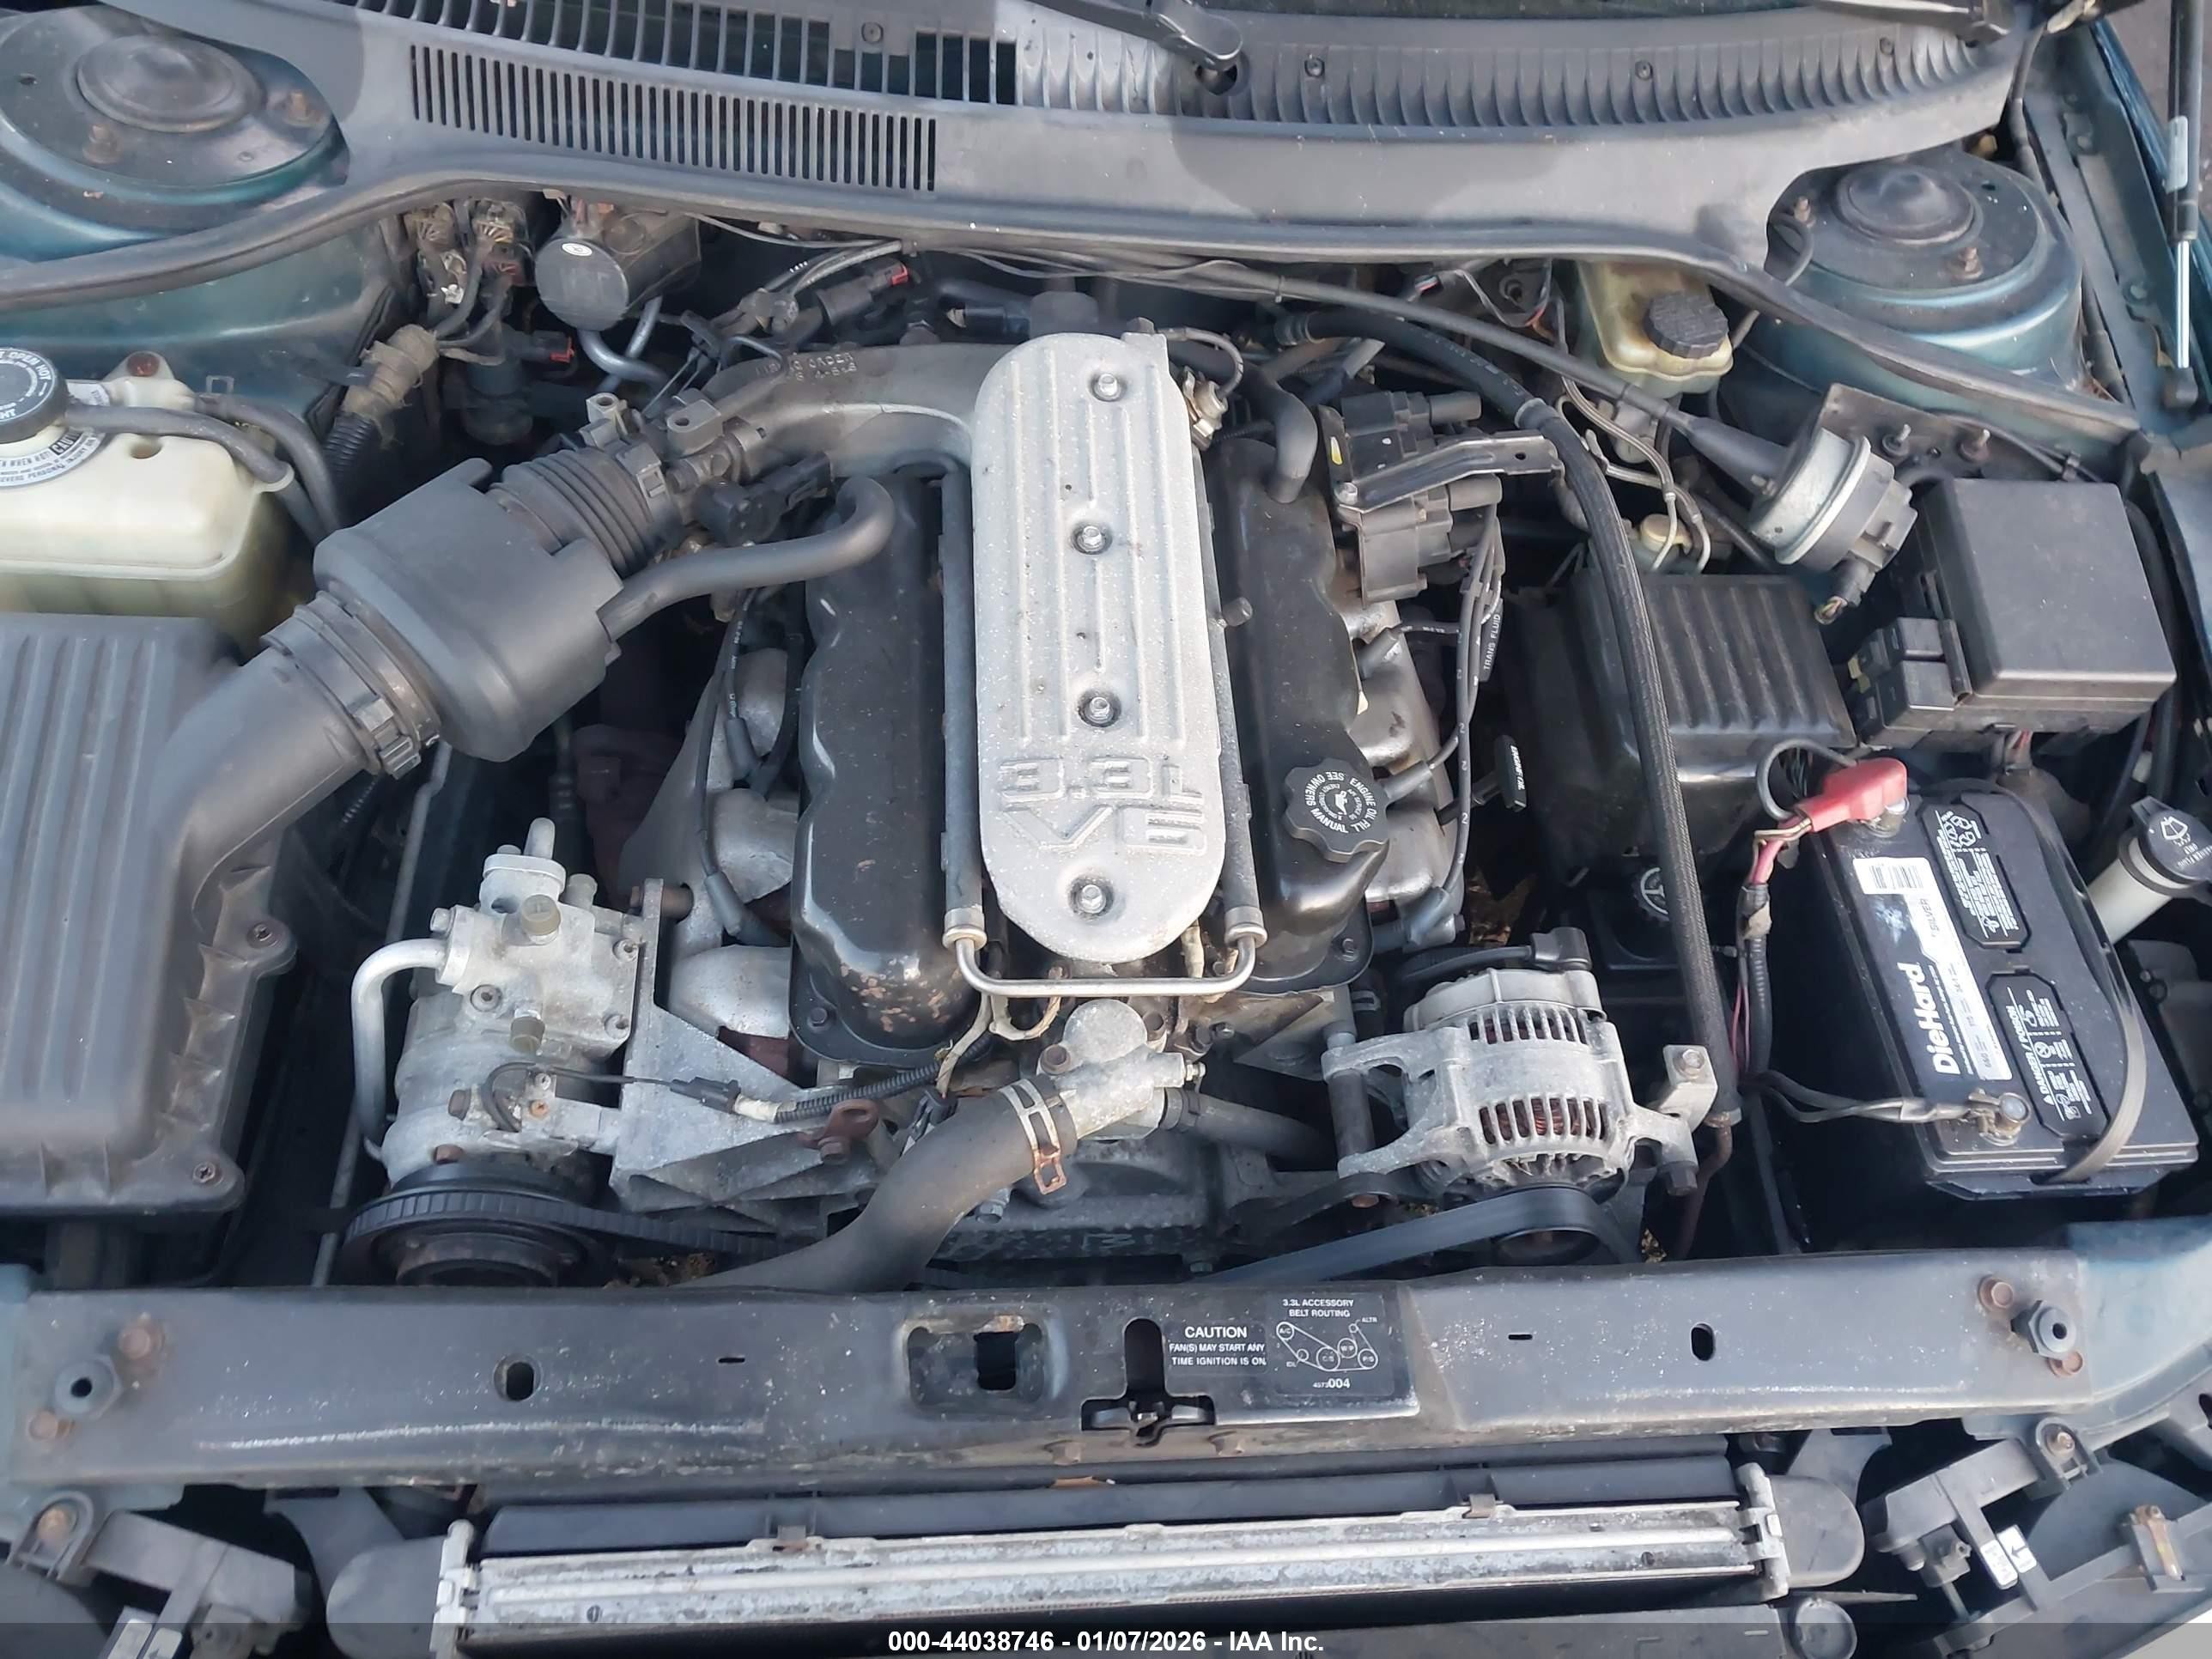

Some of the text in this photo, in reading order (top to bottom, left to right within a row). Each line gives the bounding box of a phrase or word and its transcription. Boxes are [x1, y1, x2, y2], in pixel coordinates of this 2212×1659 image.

[1491, 613, 1501, 638] FLUID
[1000, 757, 1203, 805] 3.3L
[1304, 771, 1349, 834] SEE OWNERS MANUAL
[1349, 777, 1377, 832] ENGINE OIL FILL
[1002, 803, 1208, 856] V6
[1897, 962, 1961, 1075] DieHard
[2025, 1051, 2051, 1095] DANGER
[1283, 1298, 1354, 1308] 3.3L ACCESSORY
[1289, 1309, 1351, 1318] BELT ROUTING
[1169, 1343, 1265, 1353] FAN(S) MAY START ANY
[1184, 1326, 1248, 1339] CAUTION
[1171, 1357, 1194, 1366] TIME
[1196, 1357, 1238, 1366] IGNITION
[1238, 1357, 1249, 1365] IS
